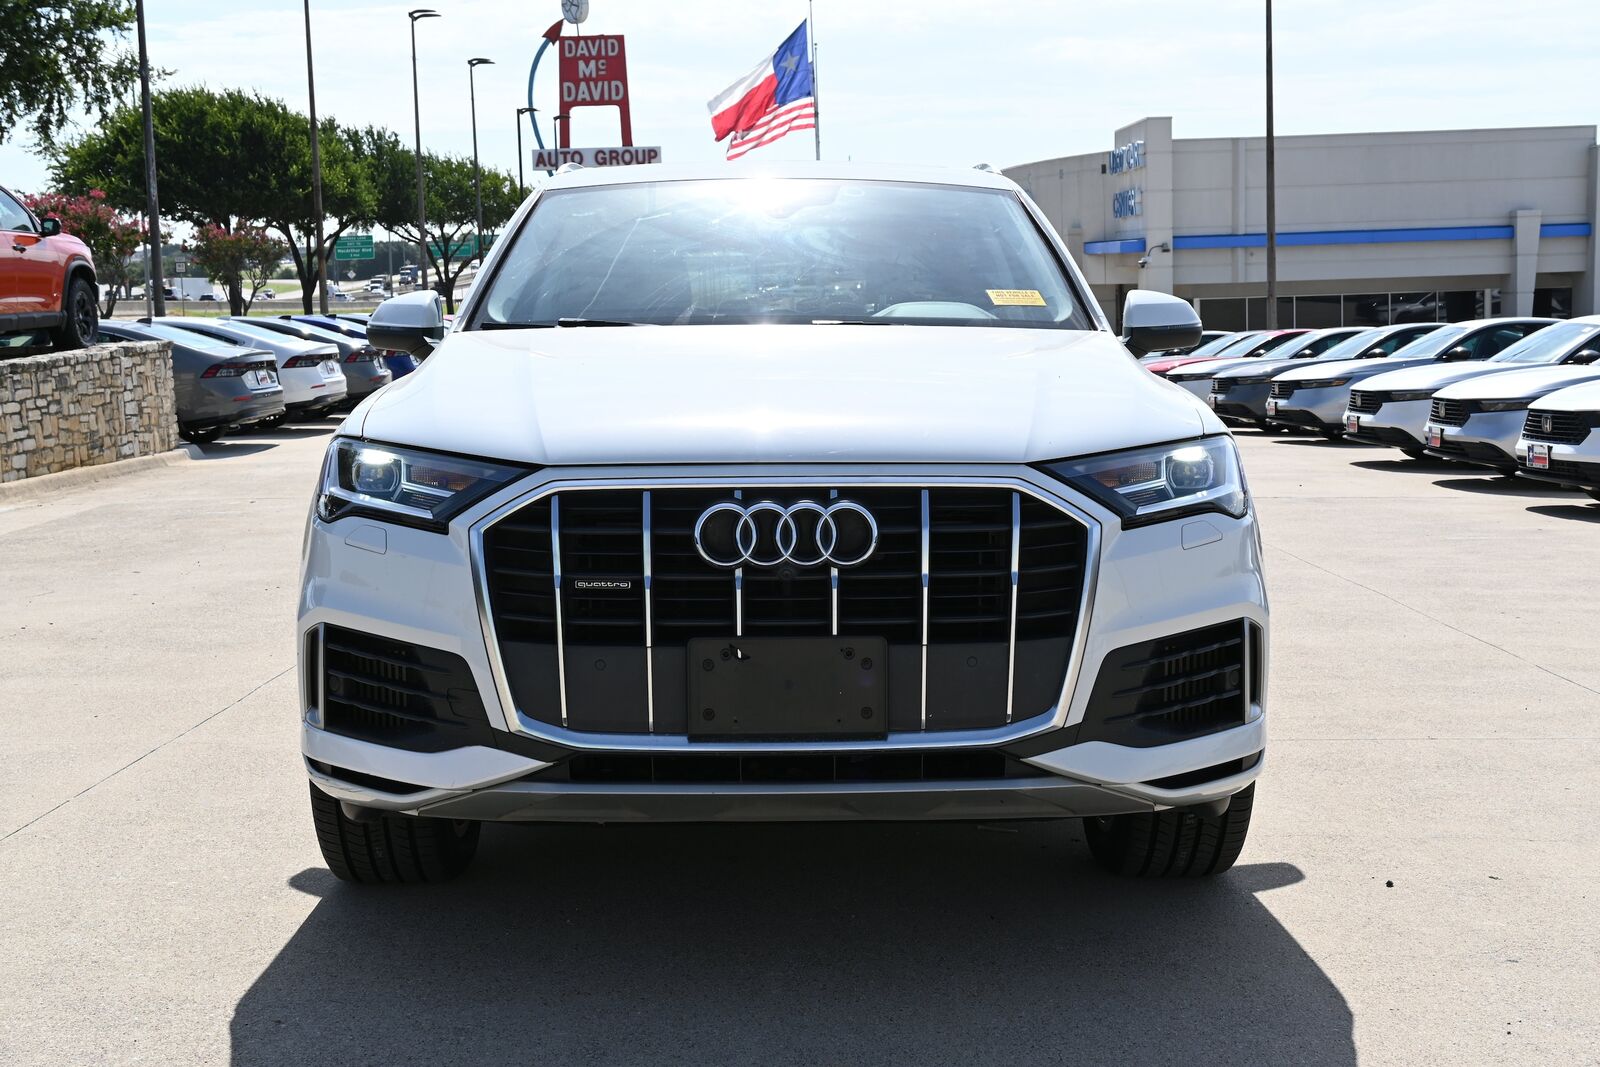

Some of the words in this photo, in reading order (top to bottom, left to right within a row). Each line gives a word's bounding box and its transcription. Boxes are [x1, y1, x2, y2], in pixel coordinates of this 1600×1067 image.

[564, 38, 619, 57] DAVID
[563, 80, 625, 102] DAVID
[535, 150, 584, 168] AUTO
[594, 148, 658, 166] GROUP
